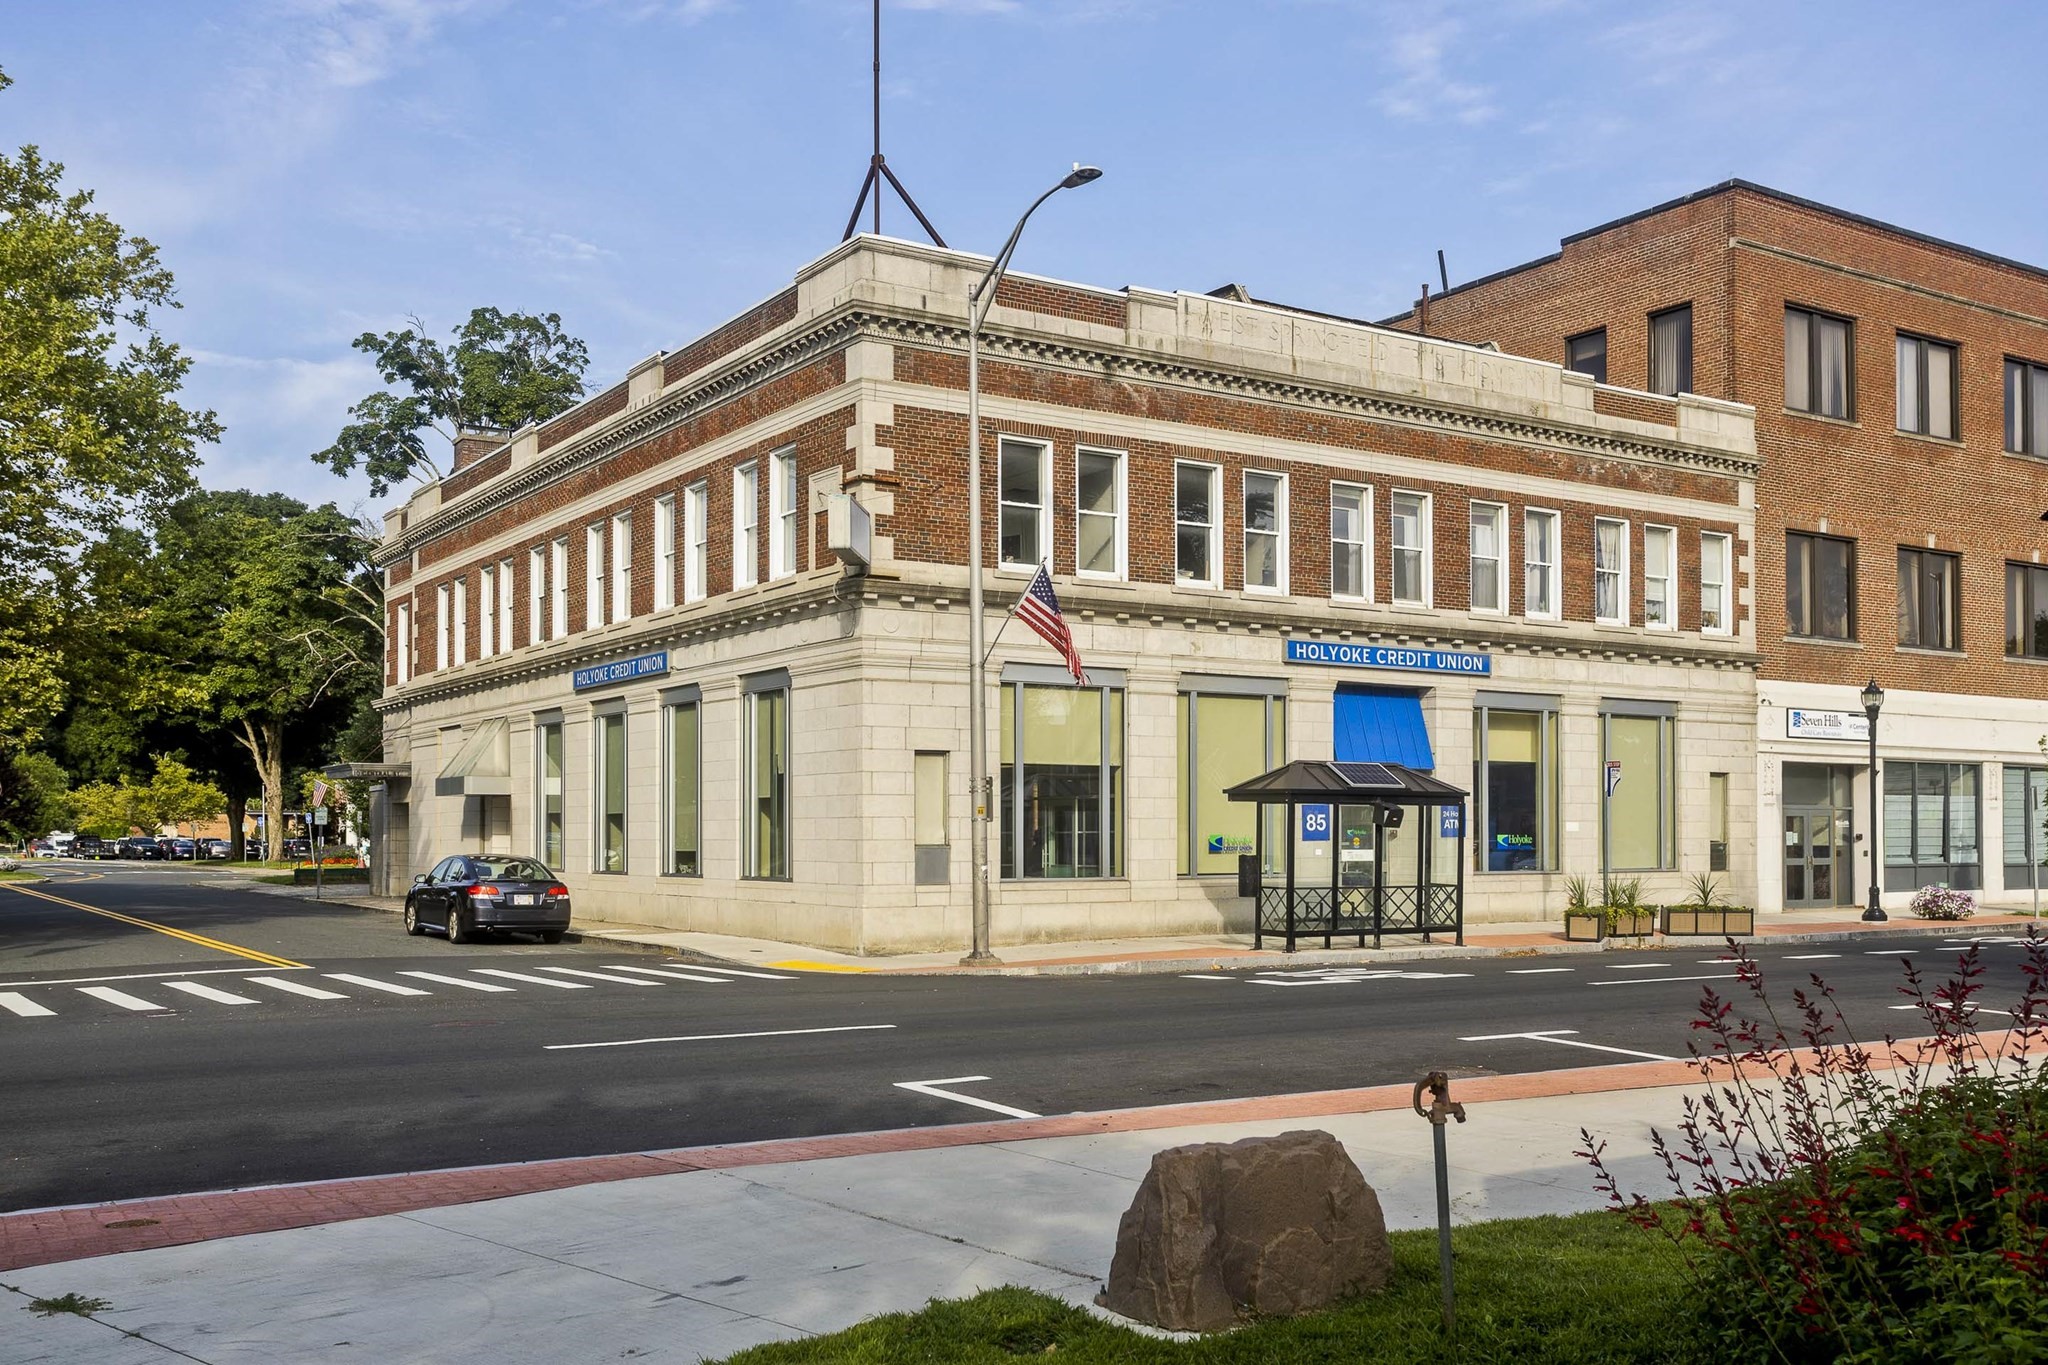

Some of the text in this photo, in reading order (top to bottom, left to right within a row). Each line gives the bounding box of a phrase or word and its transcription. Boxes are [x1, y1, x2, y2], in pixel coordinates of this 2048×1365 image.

[1268, 321, 1389, 361] SPRINGFIELD
[1296, 643, 1483, 671] HOLYOKE CREDIT UNION
[576, 655, 663, 686] HOLYOKE CREDIT UNION
[1801, 713, 1842, 728] Seven Hills
[1306, 813, 1327, 831] 85
[1442, 810, 1450, 818] 24
[1508, 834, 1533, 846] Holyoke
